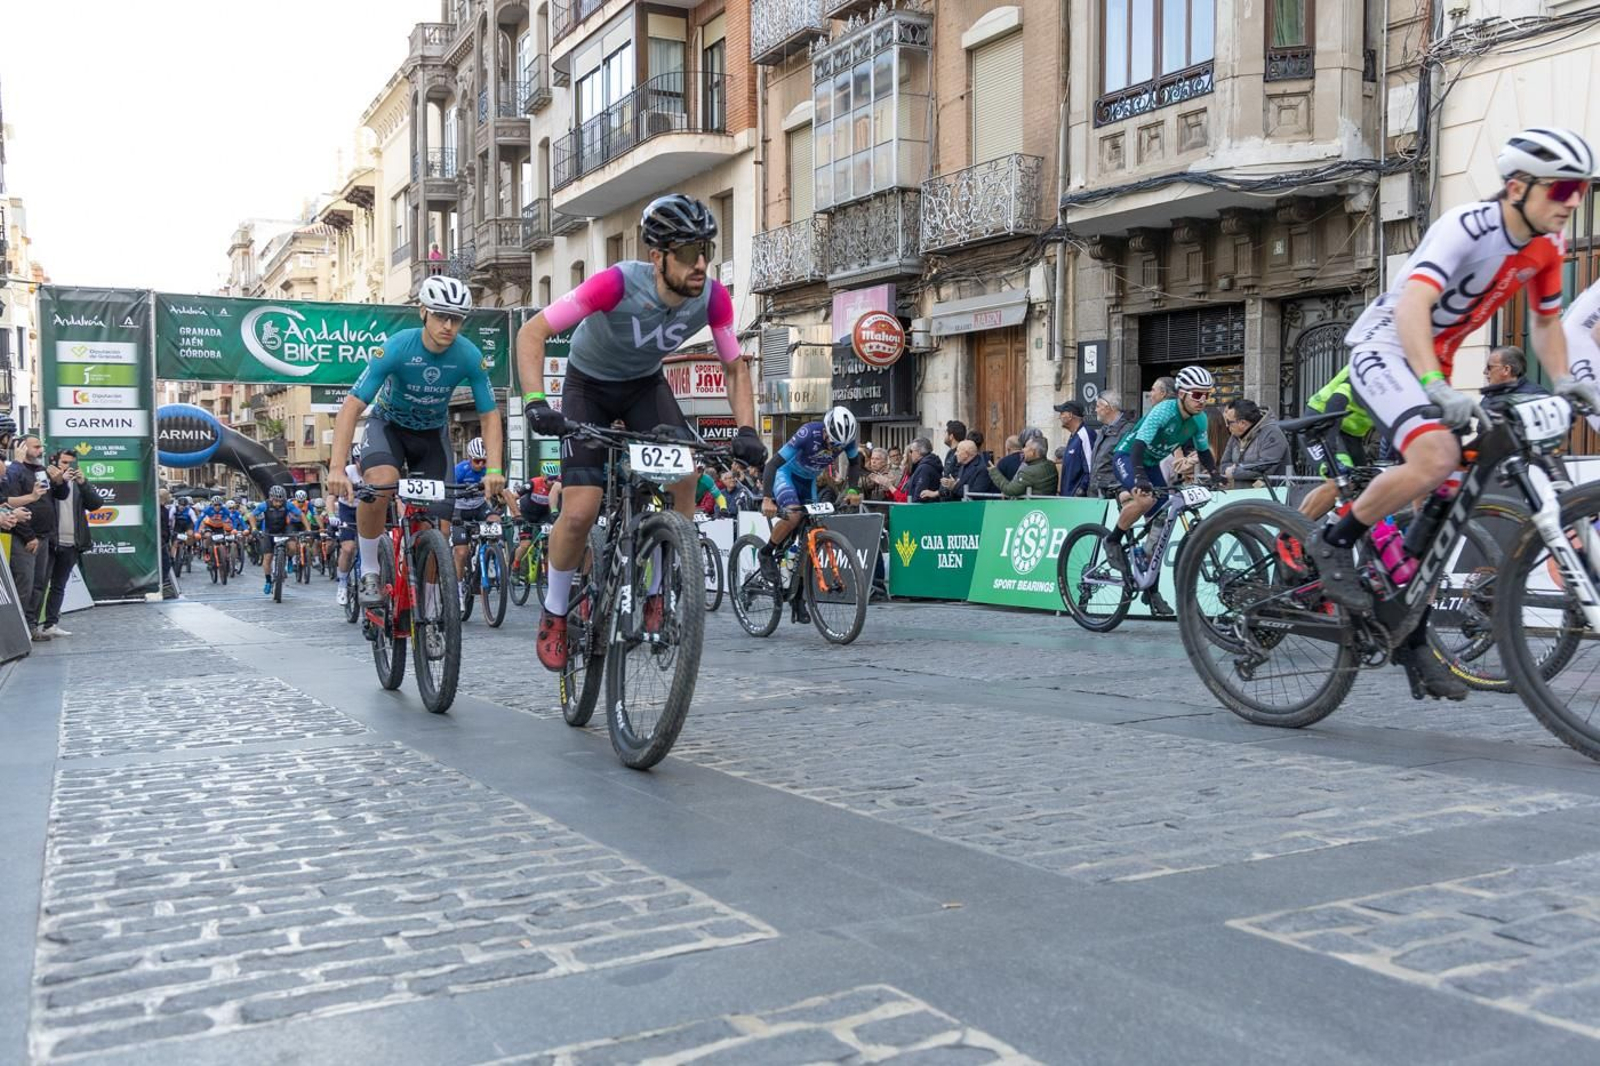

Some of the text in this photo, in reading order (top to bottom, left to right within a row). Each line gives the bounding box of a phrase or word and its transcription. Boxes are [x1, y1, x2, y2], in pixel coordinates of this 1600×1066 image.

[53, 313, 107, 329] Andalucía
[179, 326, 222, 337] GRANADA
[283, 317, 387, 343] Andalucía
[862, 330, 900, 344] Mahou
[179, 337, 203, 347] JAÉN
[179, 348, 222, 359] CÓRDOBA
[284, 343, 333, 363] BIKE
[65, 417, 133, 429] GARMIN
[158, 429, 212, 440] ARMIN
[641, 446, 683, 469] 62-2
[407, 479, 436, 497] 53-1
[88, 511, 114, 522] KH7
[1405, 464, 1480, 606] SCOTT
[920, 535, 945, 551] CAJA
[937, 551, 963, 569] JAÉN
[993, 578, 1056, 593] SPORT BEARINGS
[1257, 619, 1296, 630] SCOTT
